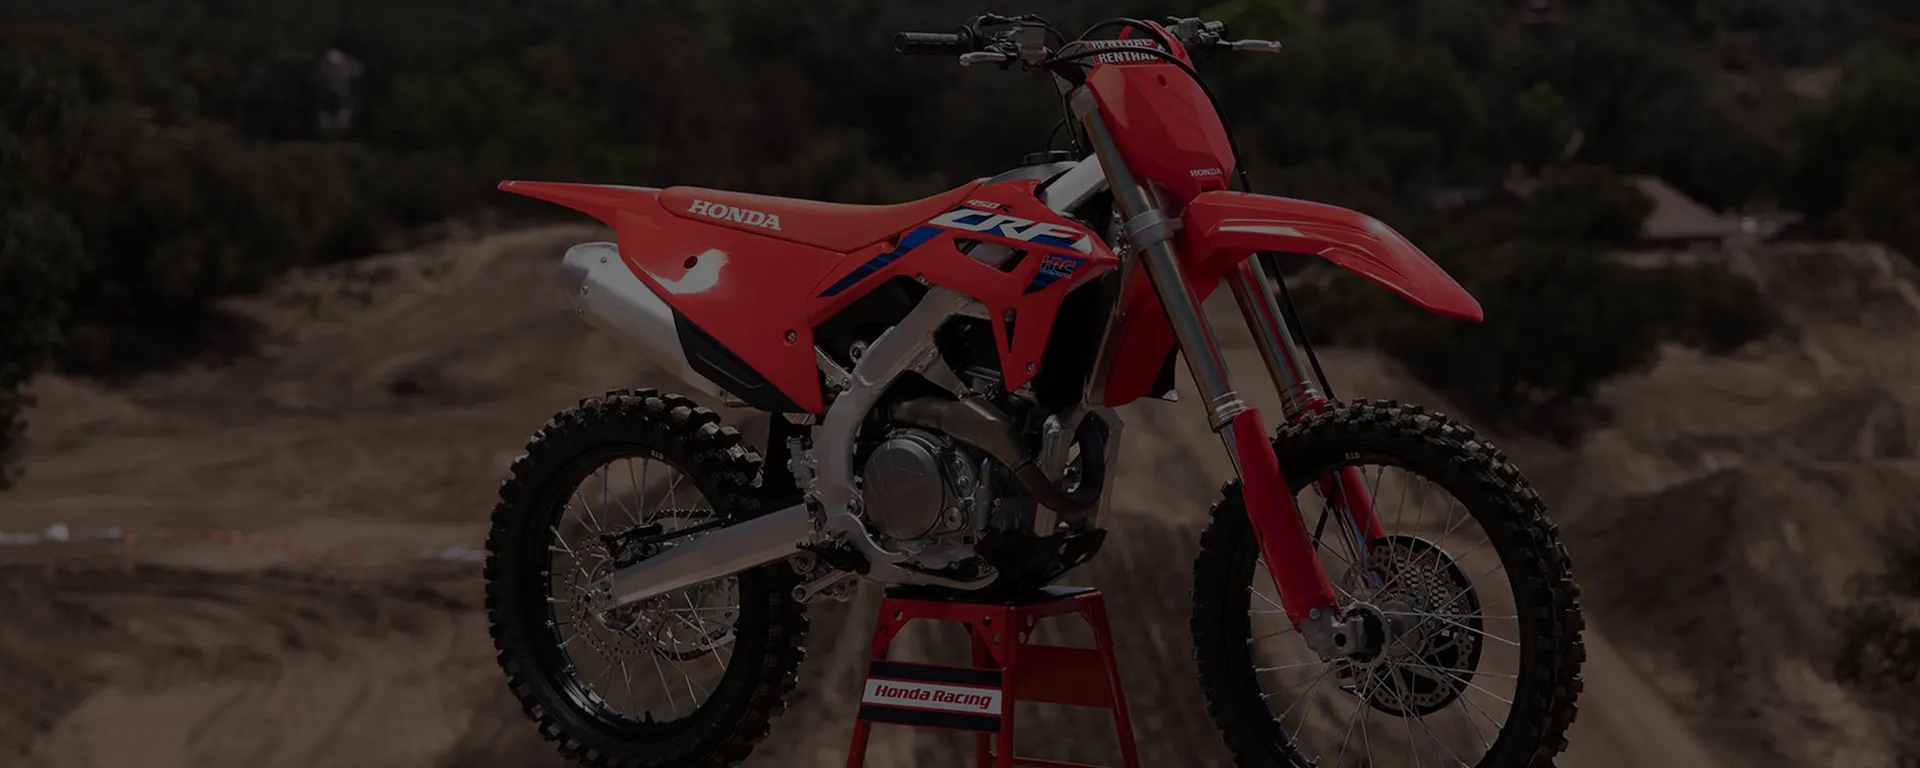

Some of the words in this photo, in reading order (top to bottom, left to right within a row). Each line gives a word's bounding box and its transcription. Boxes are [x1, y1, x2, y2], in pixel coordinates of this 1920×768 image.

[1098, 51, 1159, 63] RENTHAL
[1189, 168, 1223, 176] HONDA
[687, 199, 781, 230] HONDA
[928, 208, 1084, 241] CRF
[875, 685, 931, 701] Honda
[932, 690, 992, 709] Racing
